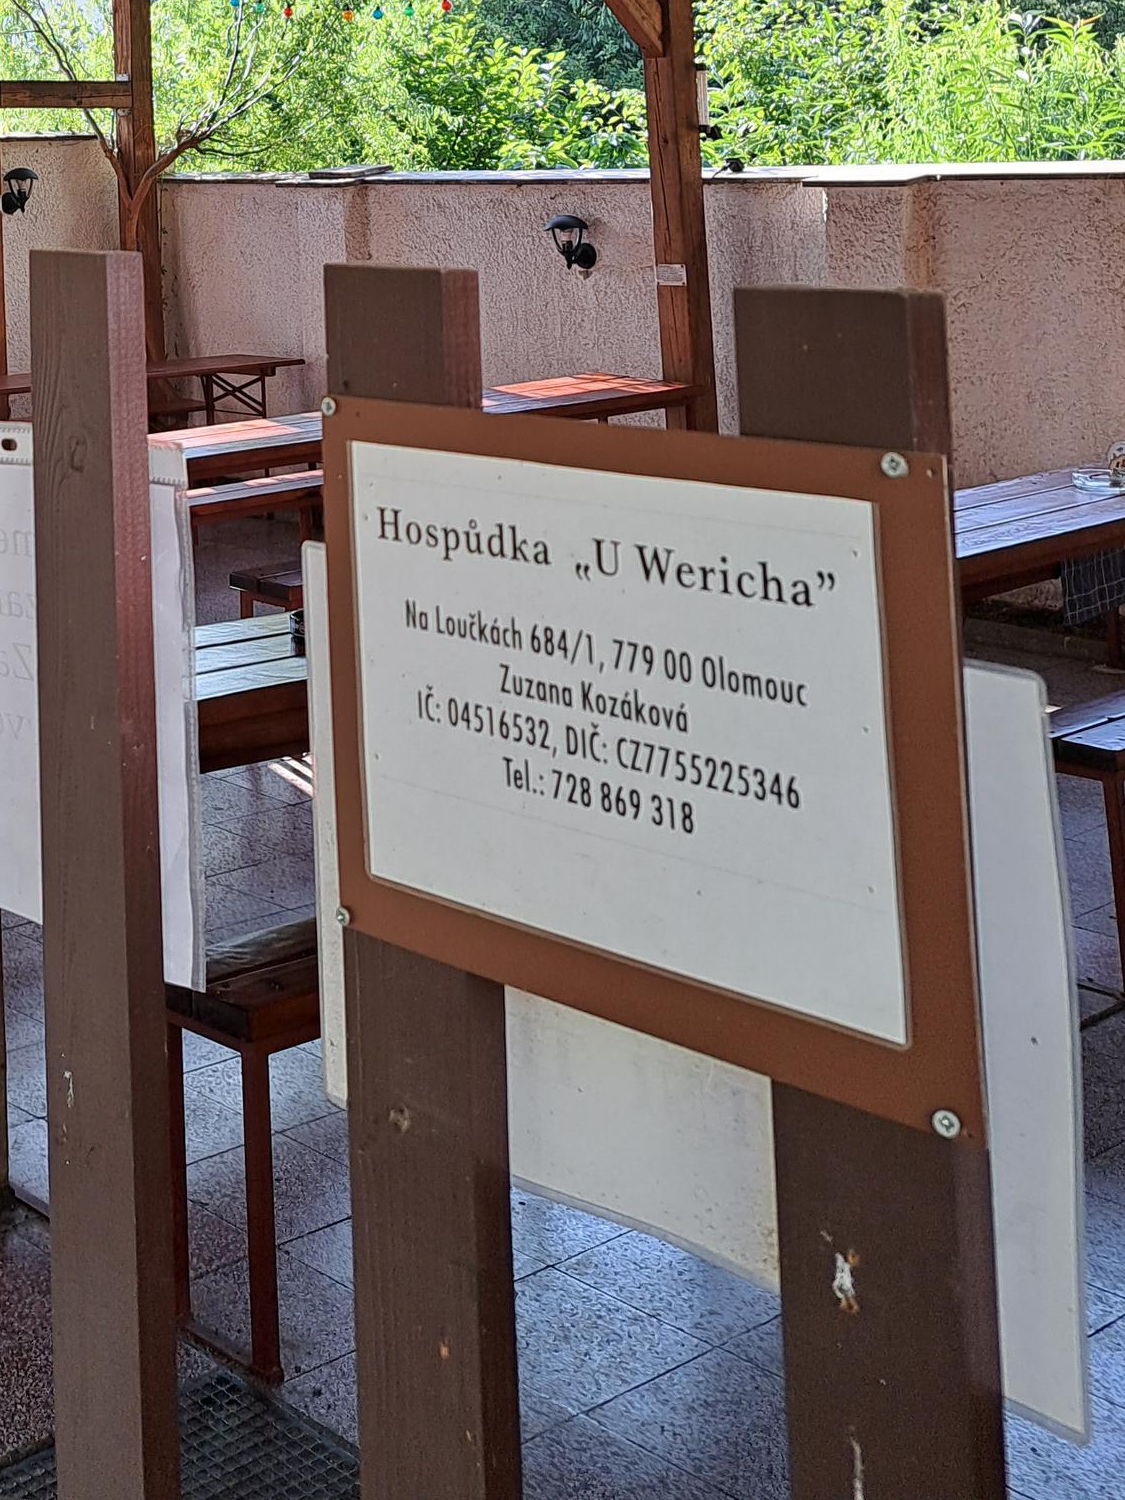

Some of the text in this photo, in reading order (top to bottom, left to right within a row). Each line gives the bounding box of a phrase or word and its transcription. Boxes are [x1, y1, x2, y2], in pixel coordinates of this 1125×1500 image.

[376, 505, 552, 567] Hospůdka
[405, 598, 809, 708] Na Loučkách 684/1, 779 00 Olomouc
[498, 663, 689, 734] Zuzana Kozáková
[417, 684, 802, 811] IČ: 04516532, DIČ: CZ7755225346
[502, 754, 696, 835] Tel.: 728 869 318
